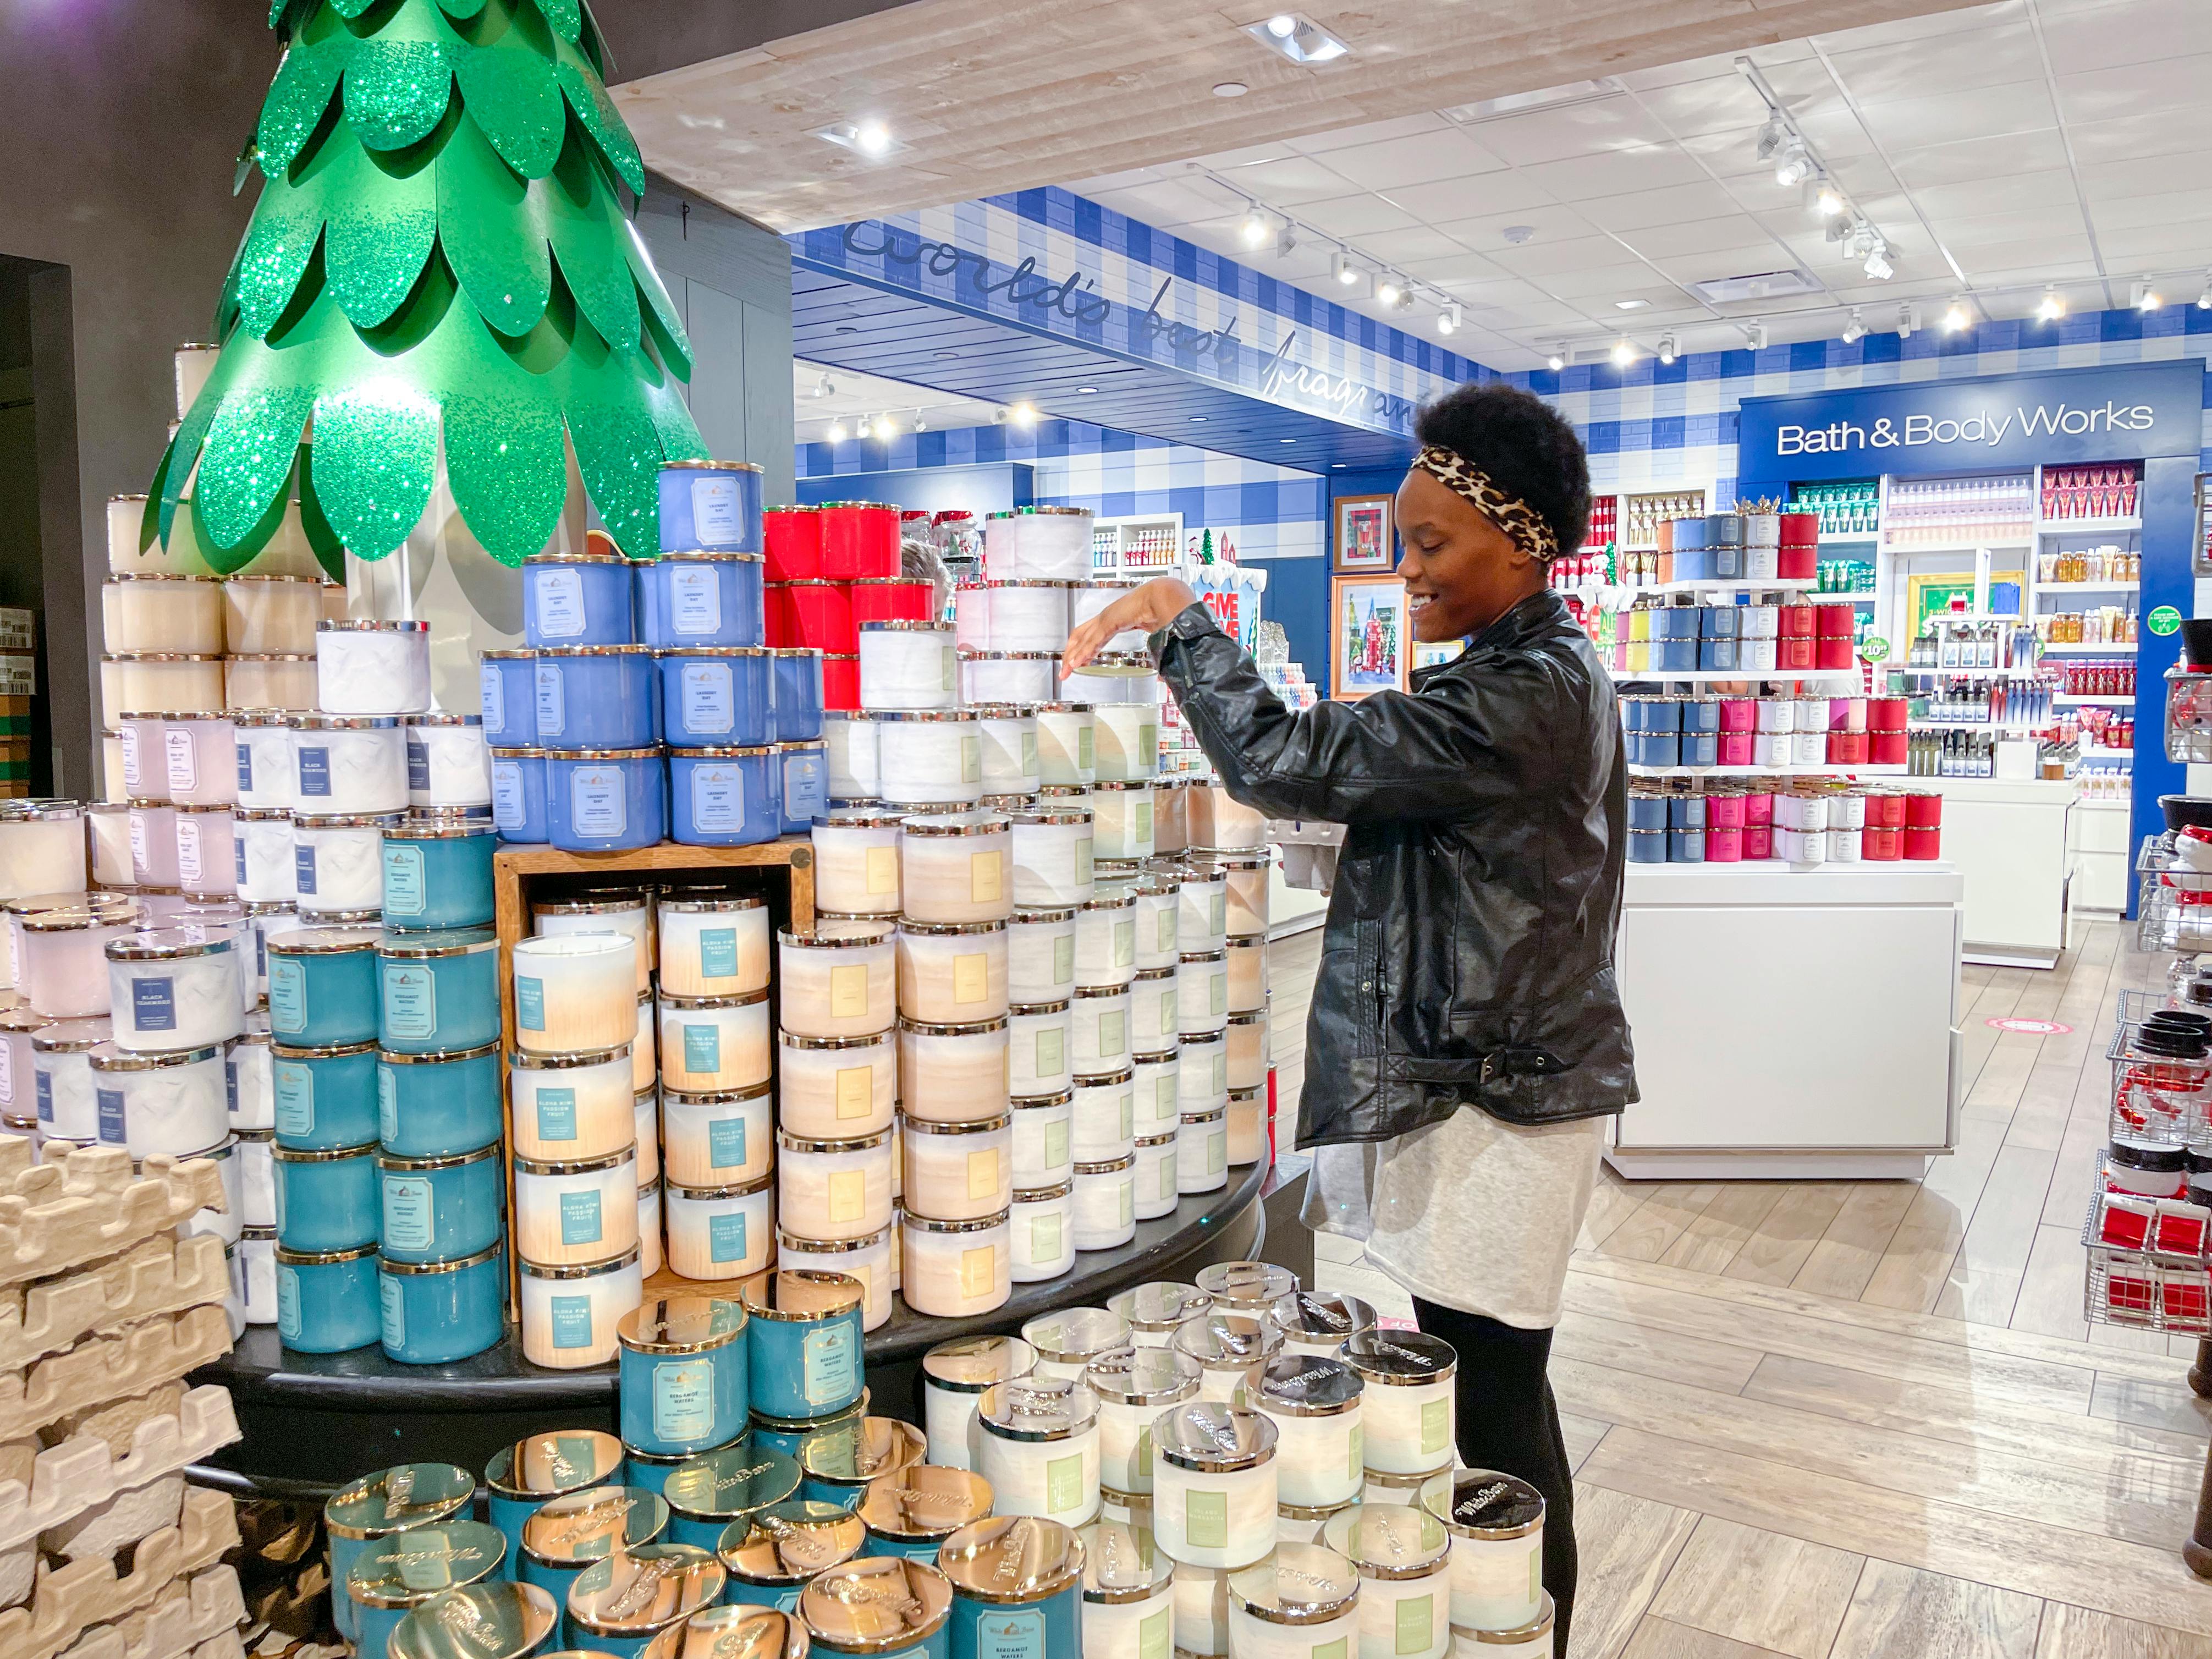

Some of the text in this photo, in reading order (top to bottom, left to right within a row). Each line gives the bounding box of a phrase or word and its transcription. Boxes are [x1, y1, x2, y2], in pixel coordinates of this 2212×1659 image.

[843, 220, 1415, 426] world's best fragran
[1778, 400, 2154, 455] Bath & Body Works
[1203, 592, 1239, 619] GIVE
[1219, 620, 1239, 642] VE
[1390, 1321, 1416, 1330] OF
[820, 1353, 844, 1363] BERGAMOT
[1454, 1481, 1508, 1516] White Barn
